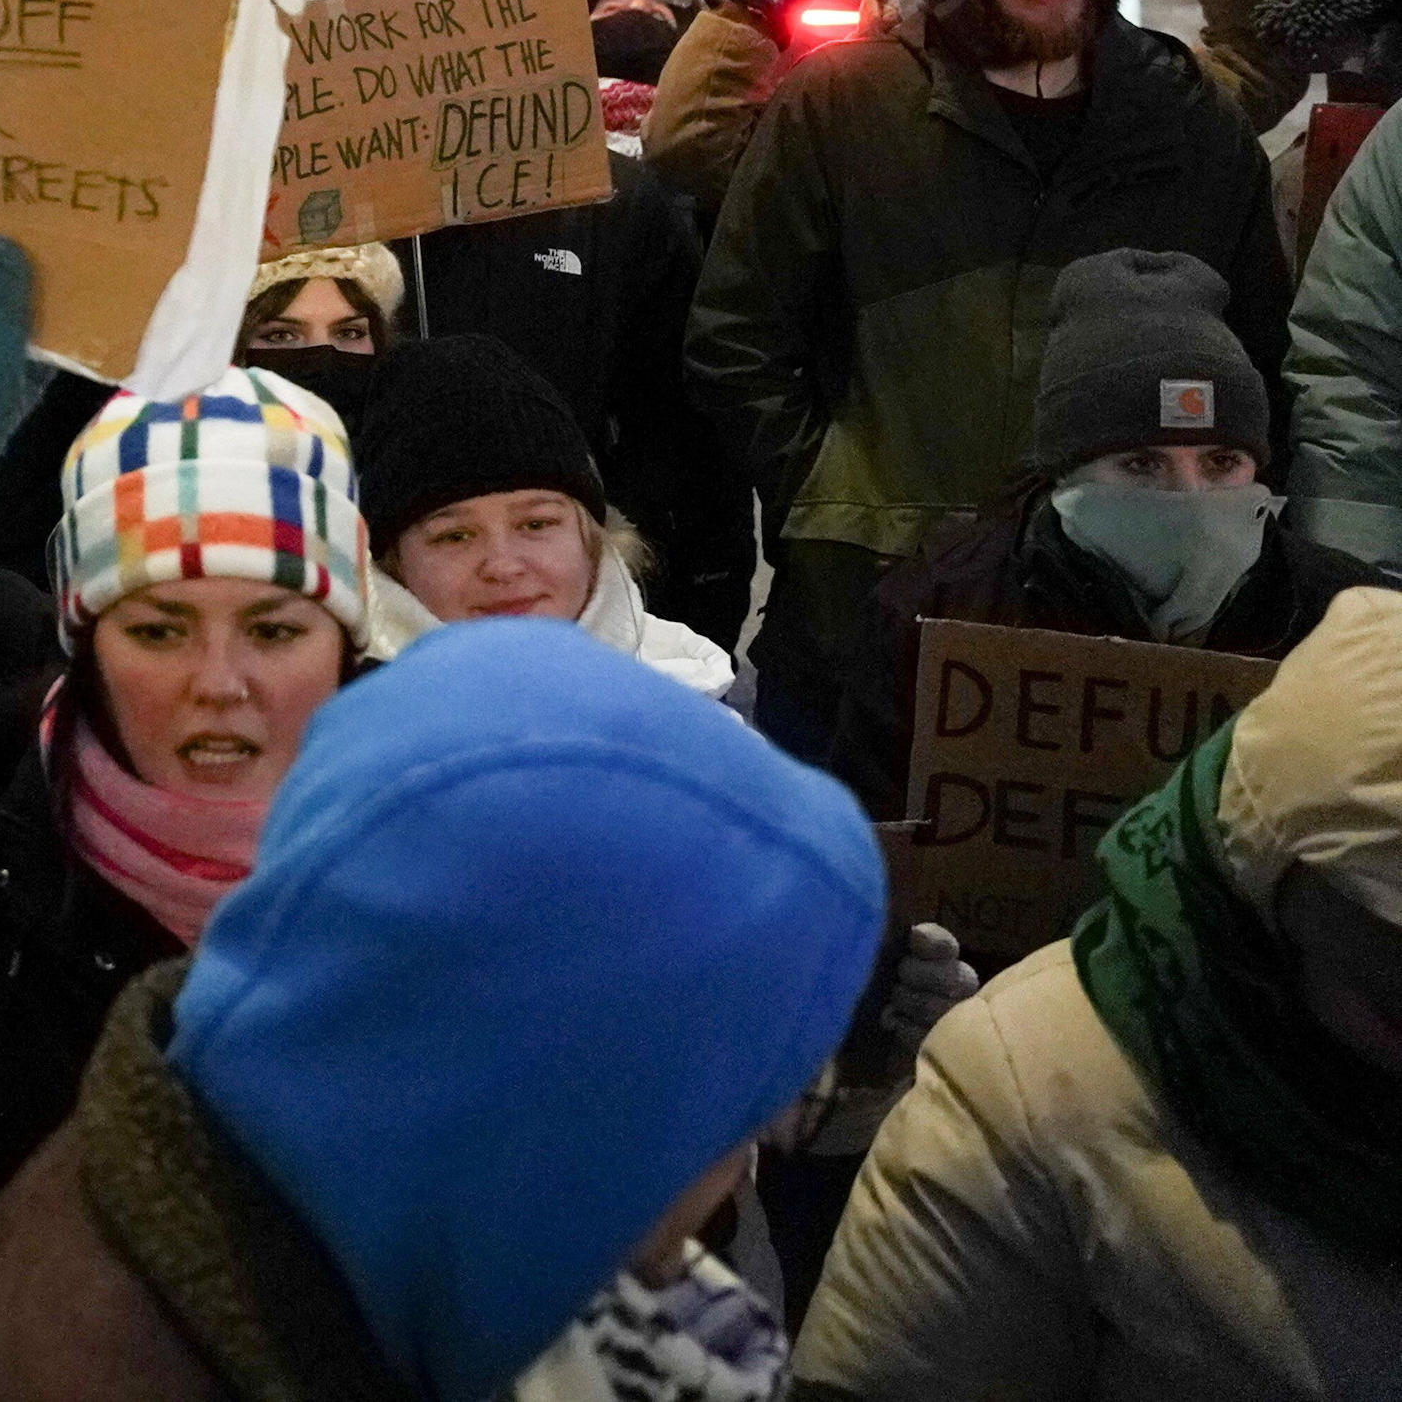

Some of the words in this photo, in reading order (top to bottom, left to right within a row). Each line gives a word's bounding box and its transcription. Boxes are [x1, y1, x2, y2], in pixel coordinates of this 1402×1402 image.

[292, 9, 413, 66] WORK
[353, 65, 398, 106] DO
[405, 45, 489, 99] WHAT
[497, 38, 556, 79] THE
[336, 115, 432, 170] WANT:
[438, 80, 593, 164] DEFUND
